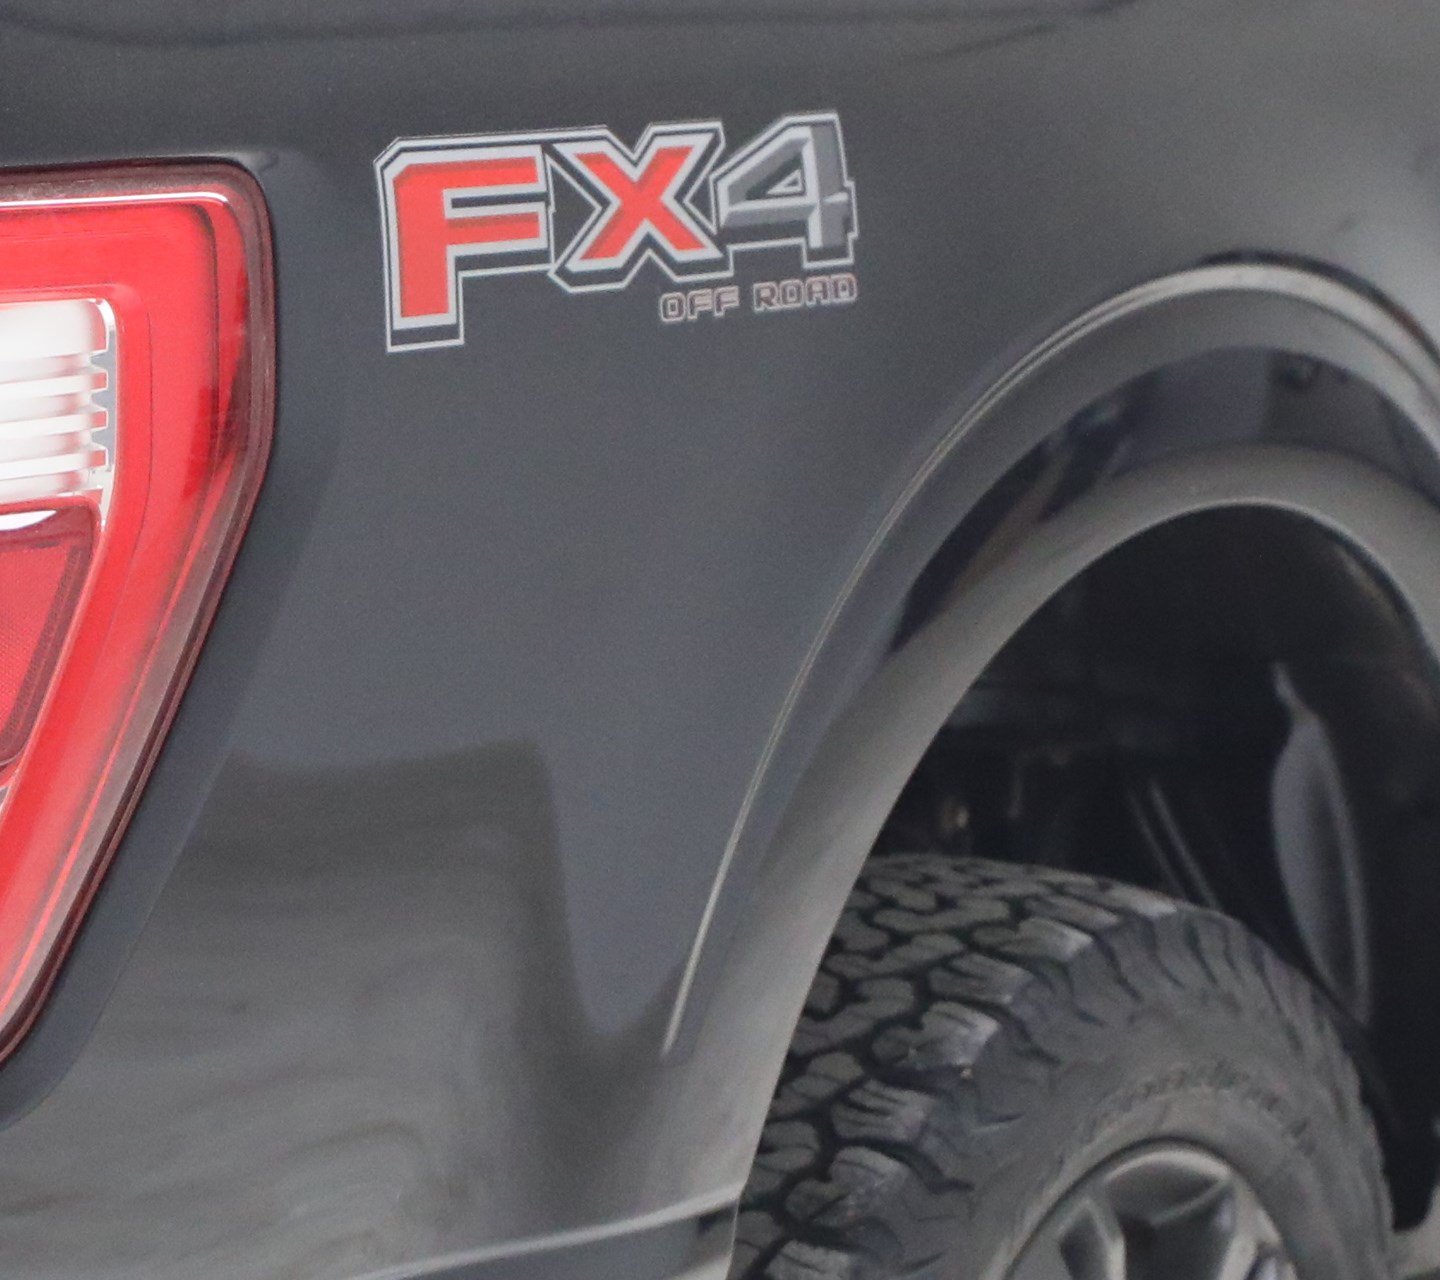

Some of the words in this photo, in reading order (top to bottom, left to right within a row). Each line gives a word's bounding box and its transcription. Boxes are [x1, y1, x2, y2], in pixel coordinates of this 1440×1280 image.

[373, 109, 859, 353] FX4
[659, 291, 738, 324] OFF
[753, 272, 858, 315] ROAD
